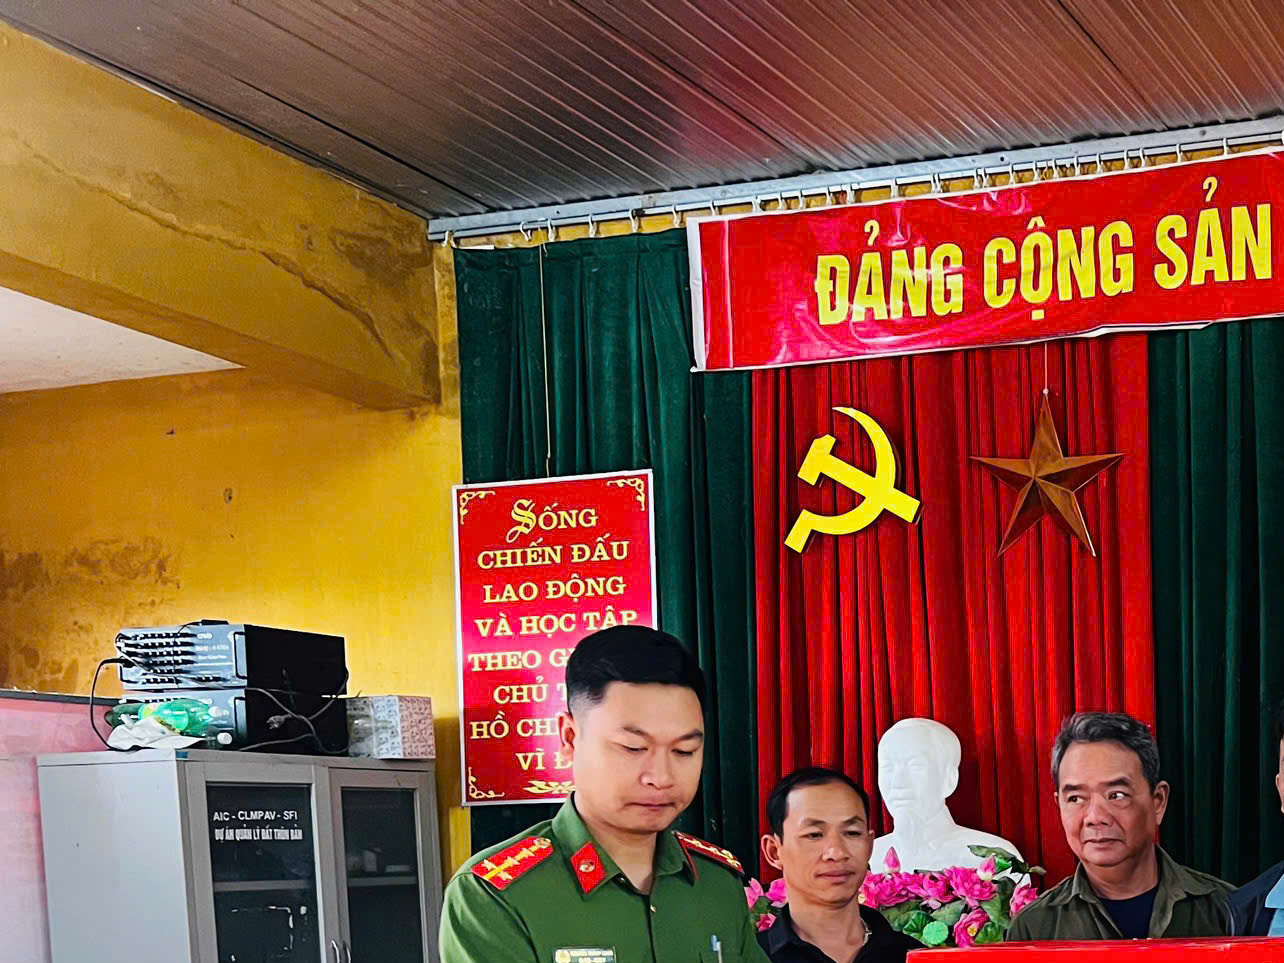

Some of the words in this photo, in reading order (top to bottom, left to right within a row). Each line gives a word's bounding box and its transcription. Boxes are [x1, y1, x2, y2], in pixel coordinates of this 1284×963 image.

[813, 219, 964, 325] ĐẢNG
[983, 216, 1134, 320] CỘNG
[1154, 176, 1272, 289] SẢN
[477, 537, 563, 569] CHIẾN
[571, 533, 630, 562] ĐẤU
[483, 582, 538, 603] LAO
[545, 573, 626, 602] ĐỘNG
[475, 612, 513, 637] VÀ
[520, 613, 576, 638] HỌC
[467, 650, 542, 671] THEO
[493, 675, 548, 704] CHỦ
[469, 711, 509, 739] HỒ
[213, 811, 230, 821] AIC
[237, 810, 276, 820] CLMPAV
[283, 810, 298, 820] SFI
